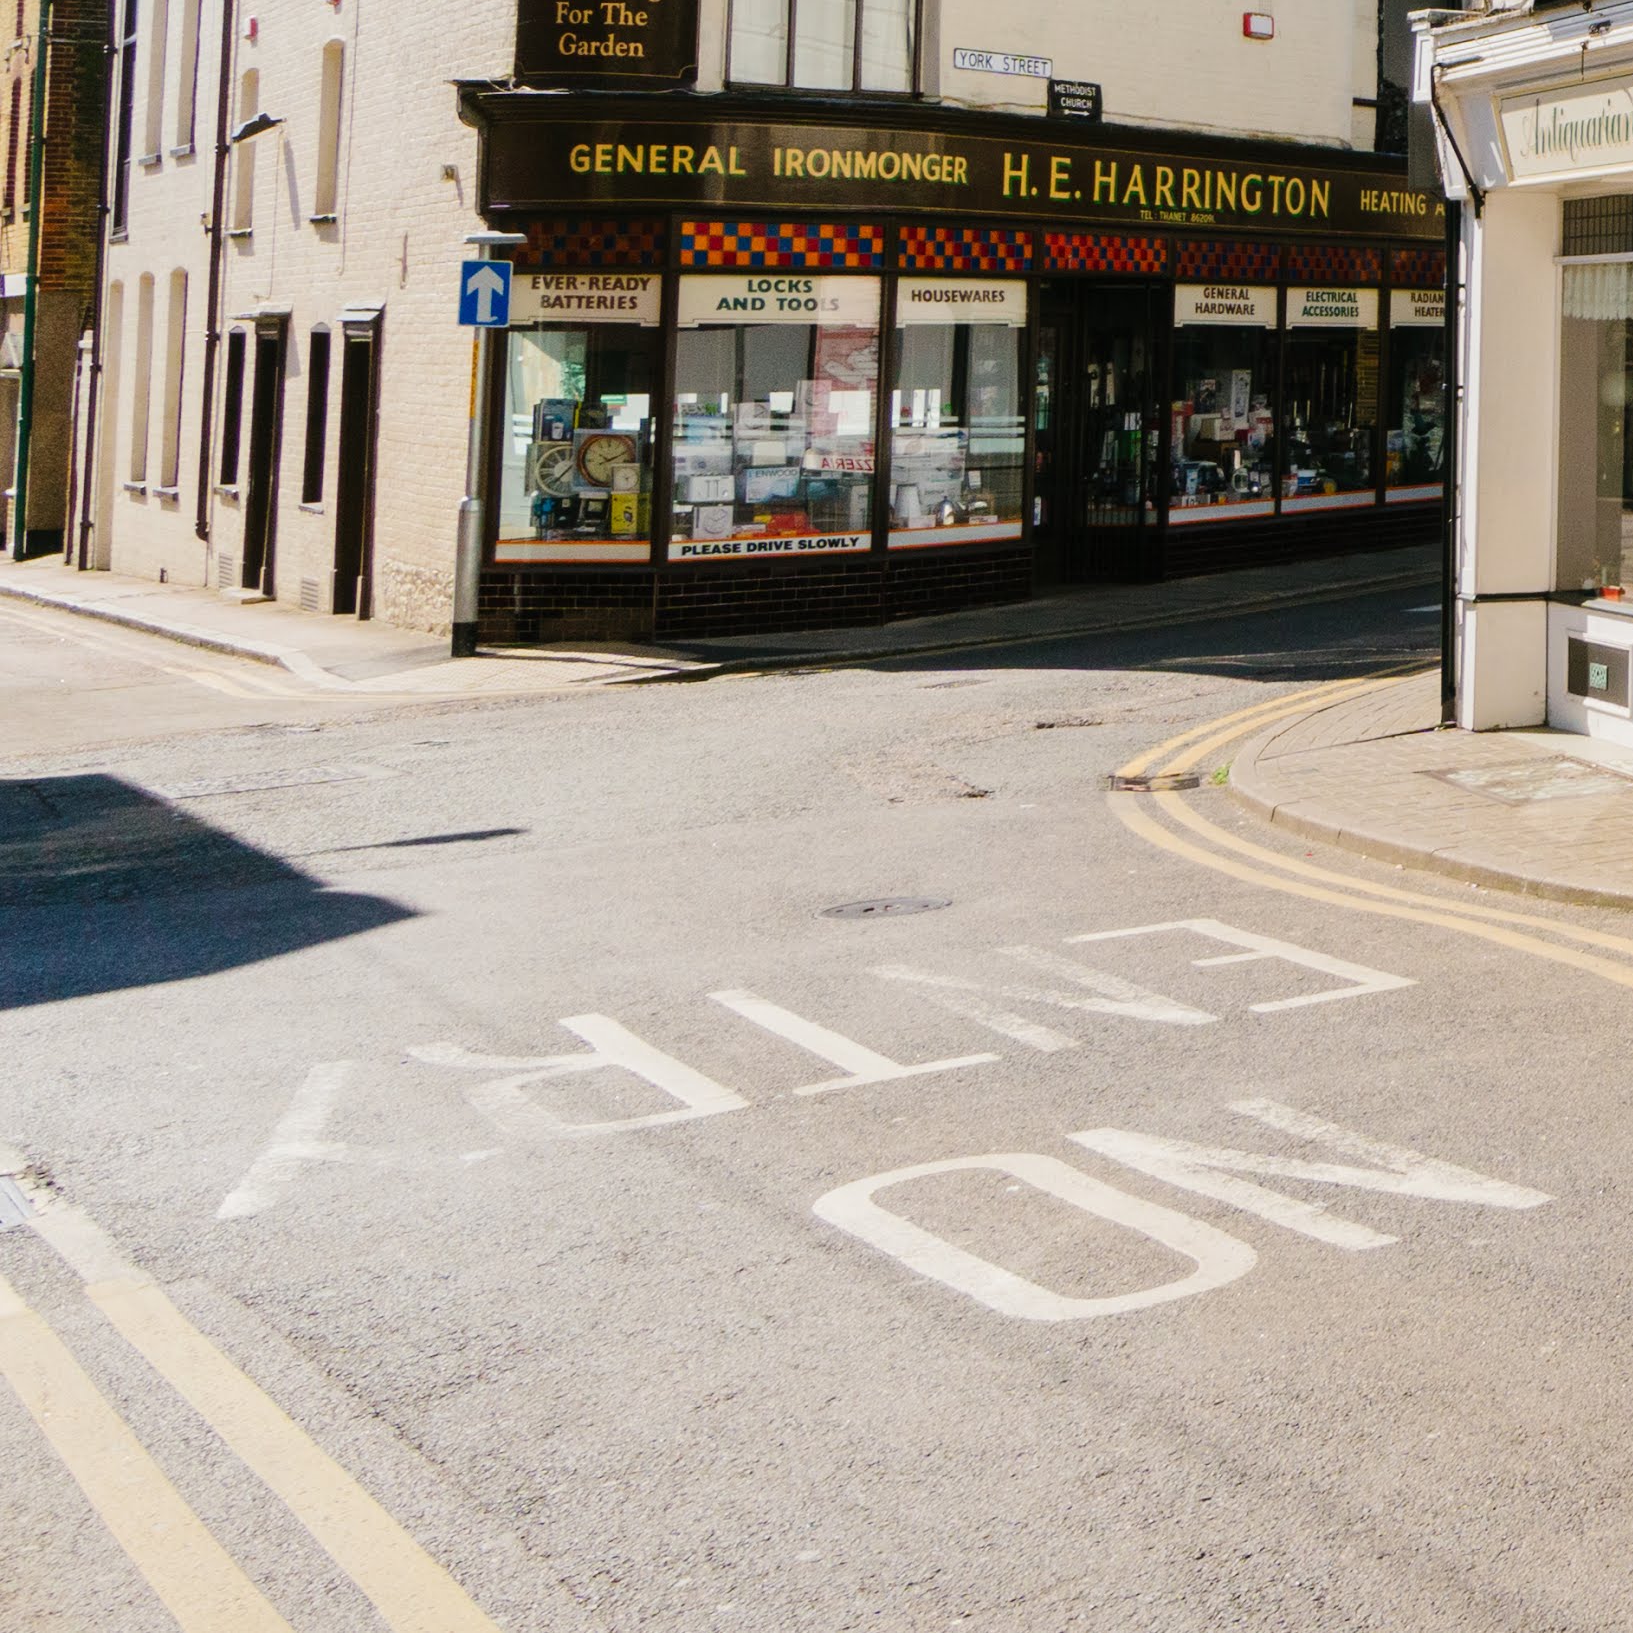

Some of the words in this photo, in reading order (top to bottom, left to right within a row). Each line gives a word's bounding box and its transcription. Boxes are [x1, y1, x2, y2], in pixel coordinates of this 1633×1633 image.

[555, 1, 593, 24] For
[600, 2, 648, 26] The
[558, 32, 645, 57] Garden
[960, 51, 993, 69] YORK
[1003, 56, 1048, 75] STREET
[1054, 84, 1096, 96] METHODIST
[1060, 97, 1092, 109] CHURCH
[569, 143, 747, 175] GENERAL
[773, 147, 969, 185] IRONMONGER
[1002, 152, 1037, 199] H.
[1049, 156, 1082, 201] E.
[1093, 160, 1332, 217] HARRINGTON
[1360, 189, 1426, 215] HEATING
[530, 275, 651, 291] EVER-READY
[747, 279, 813, 294] LOCKS
[911, 288, 1005, 305] HOUSEWARES
[1203, 286, 1250, 300] GENERAL
[1306, 291, 1358, 304] ELECTRICAL
[540, 295, 638, 310] BATTERIES
[716, 297, 766, 311] AND
[778, 297, 840, 311] TOOLS
[1195, 302, 1255, 316] HARDWARE
[1302, 305, 1359, 317] ACCESSORIES
[681, 541, 742, 556] PLEASE
[746, 539, 795, 553] DRIVE
[797, 536, 860, 550] SLOWLY
[812, 1098, 1556, 1322] NO
